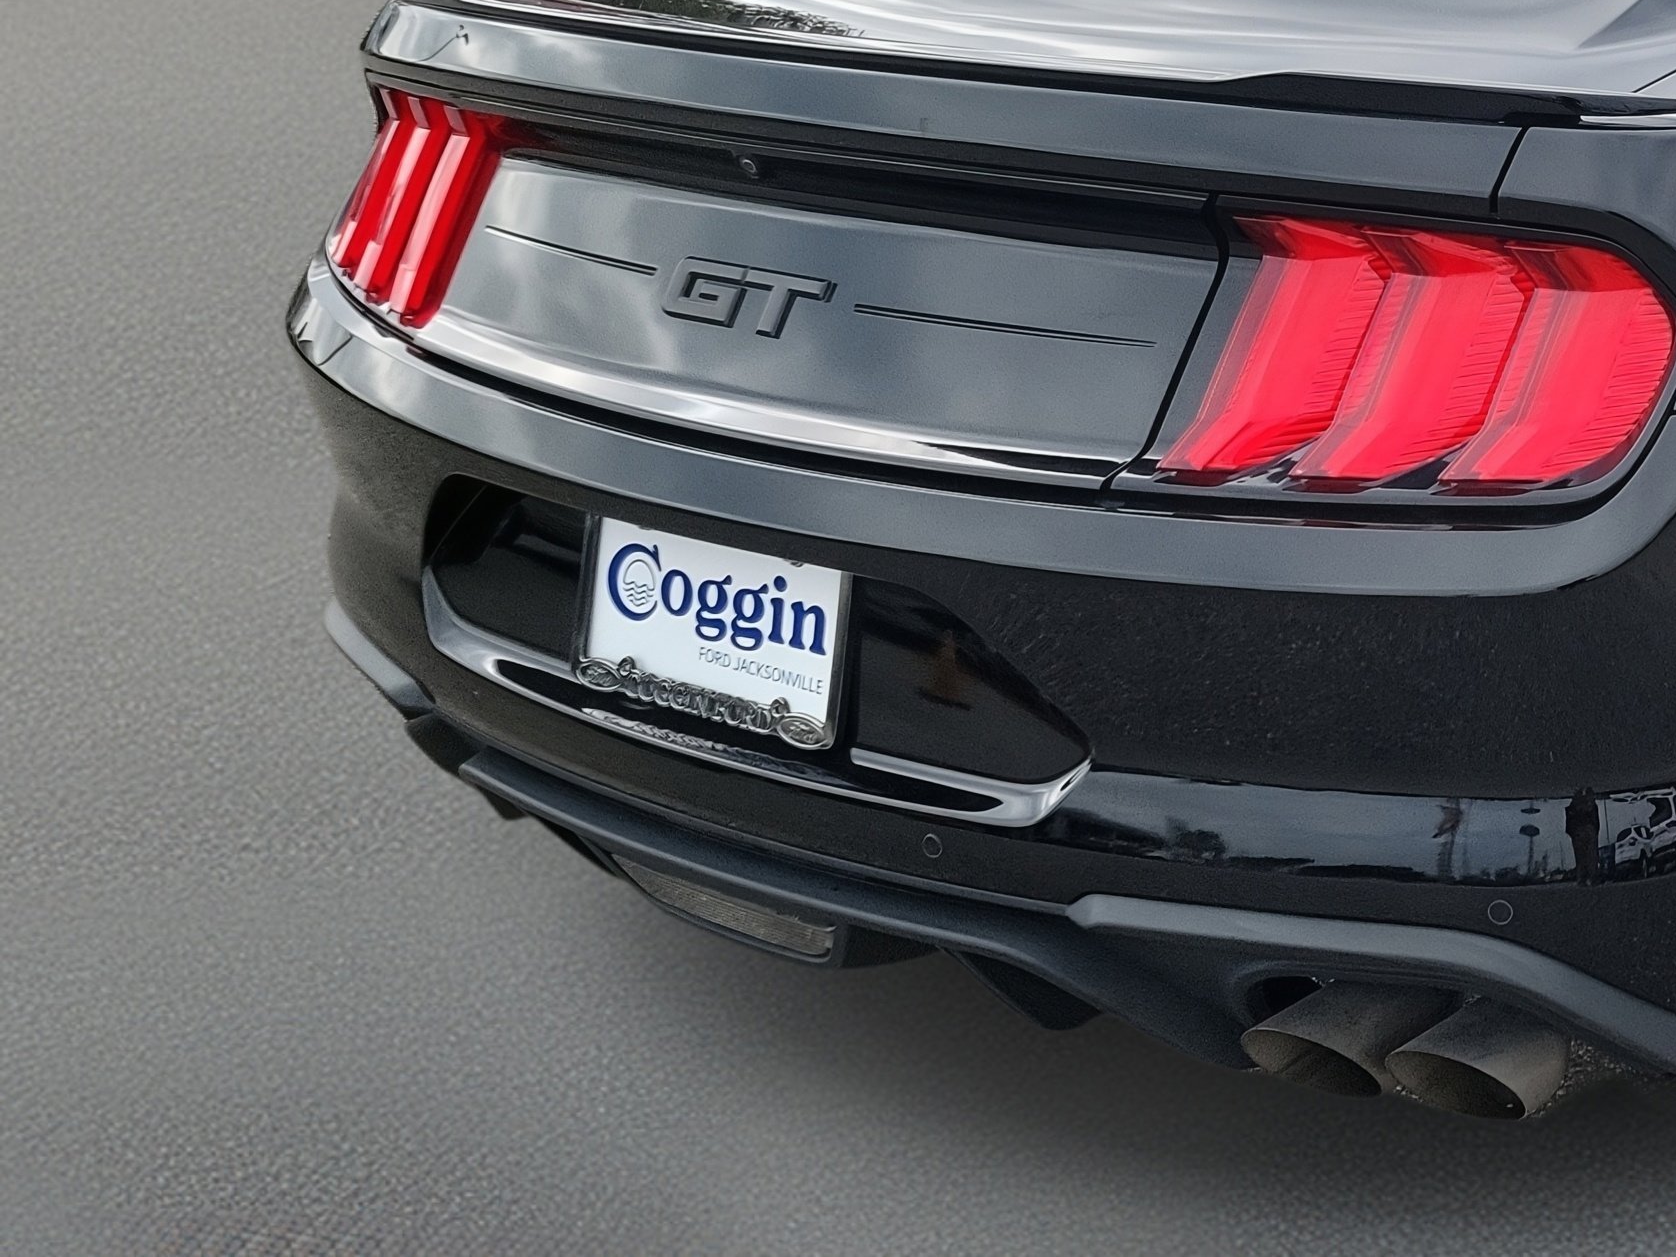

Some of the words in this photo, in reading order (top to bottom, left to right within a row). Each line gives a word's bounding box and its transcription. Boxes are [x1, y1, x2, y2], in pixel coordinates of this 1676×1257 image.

[661, 255, 838, 340] GT
[607, 543, 827, 656] Coggin
[698, 646, 731, 668] FORD
[733, 656, 824, 695] JACKSONVILLE
